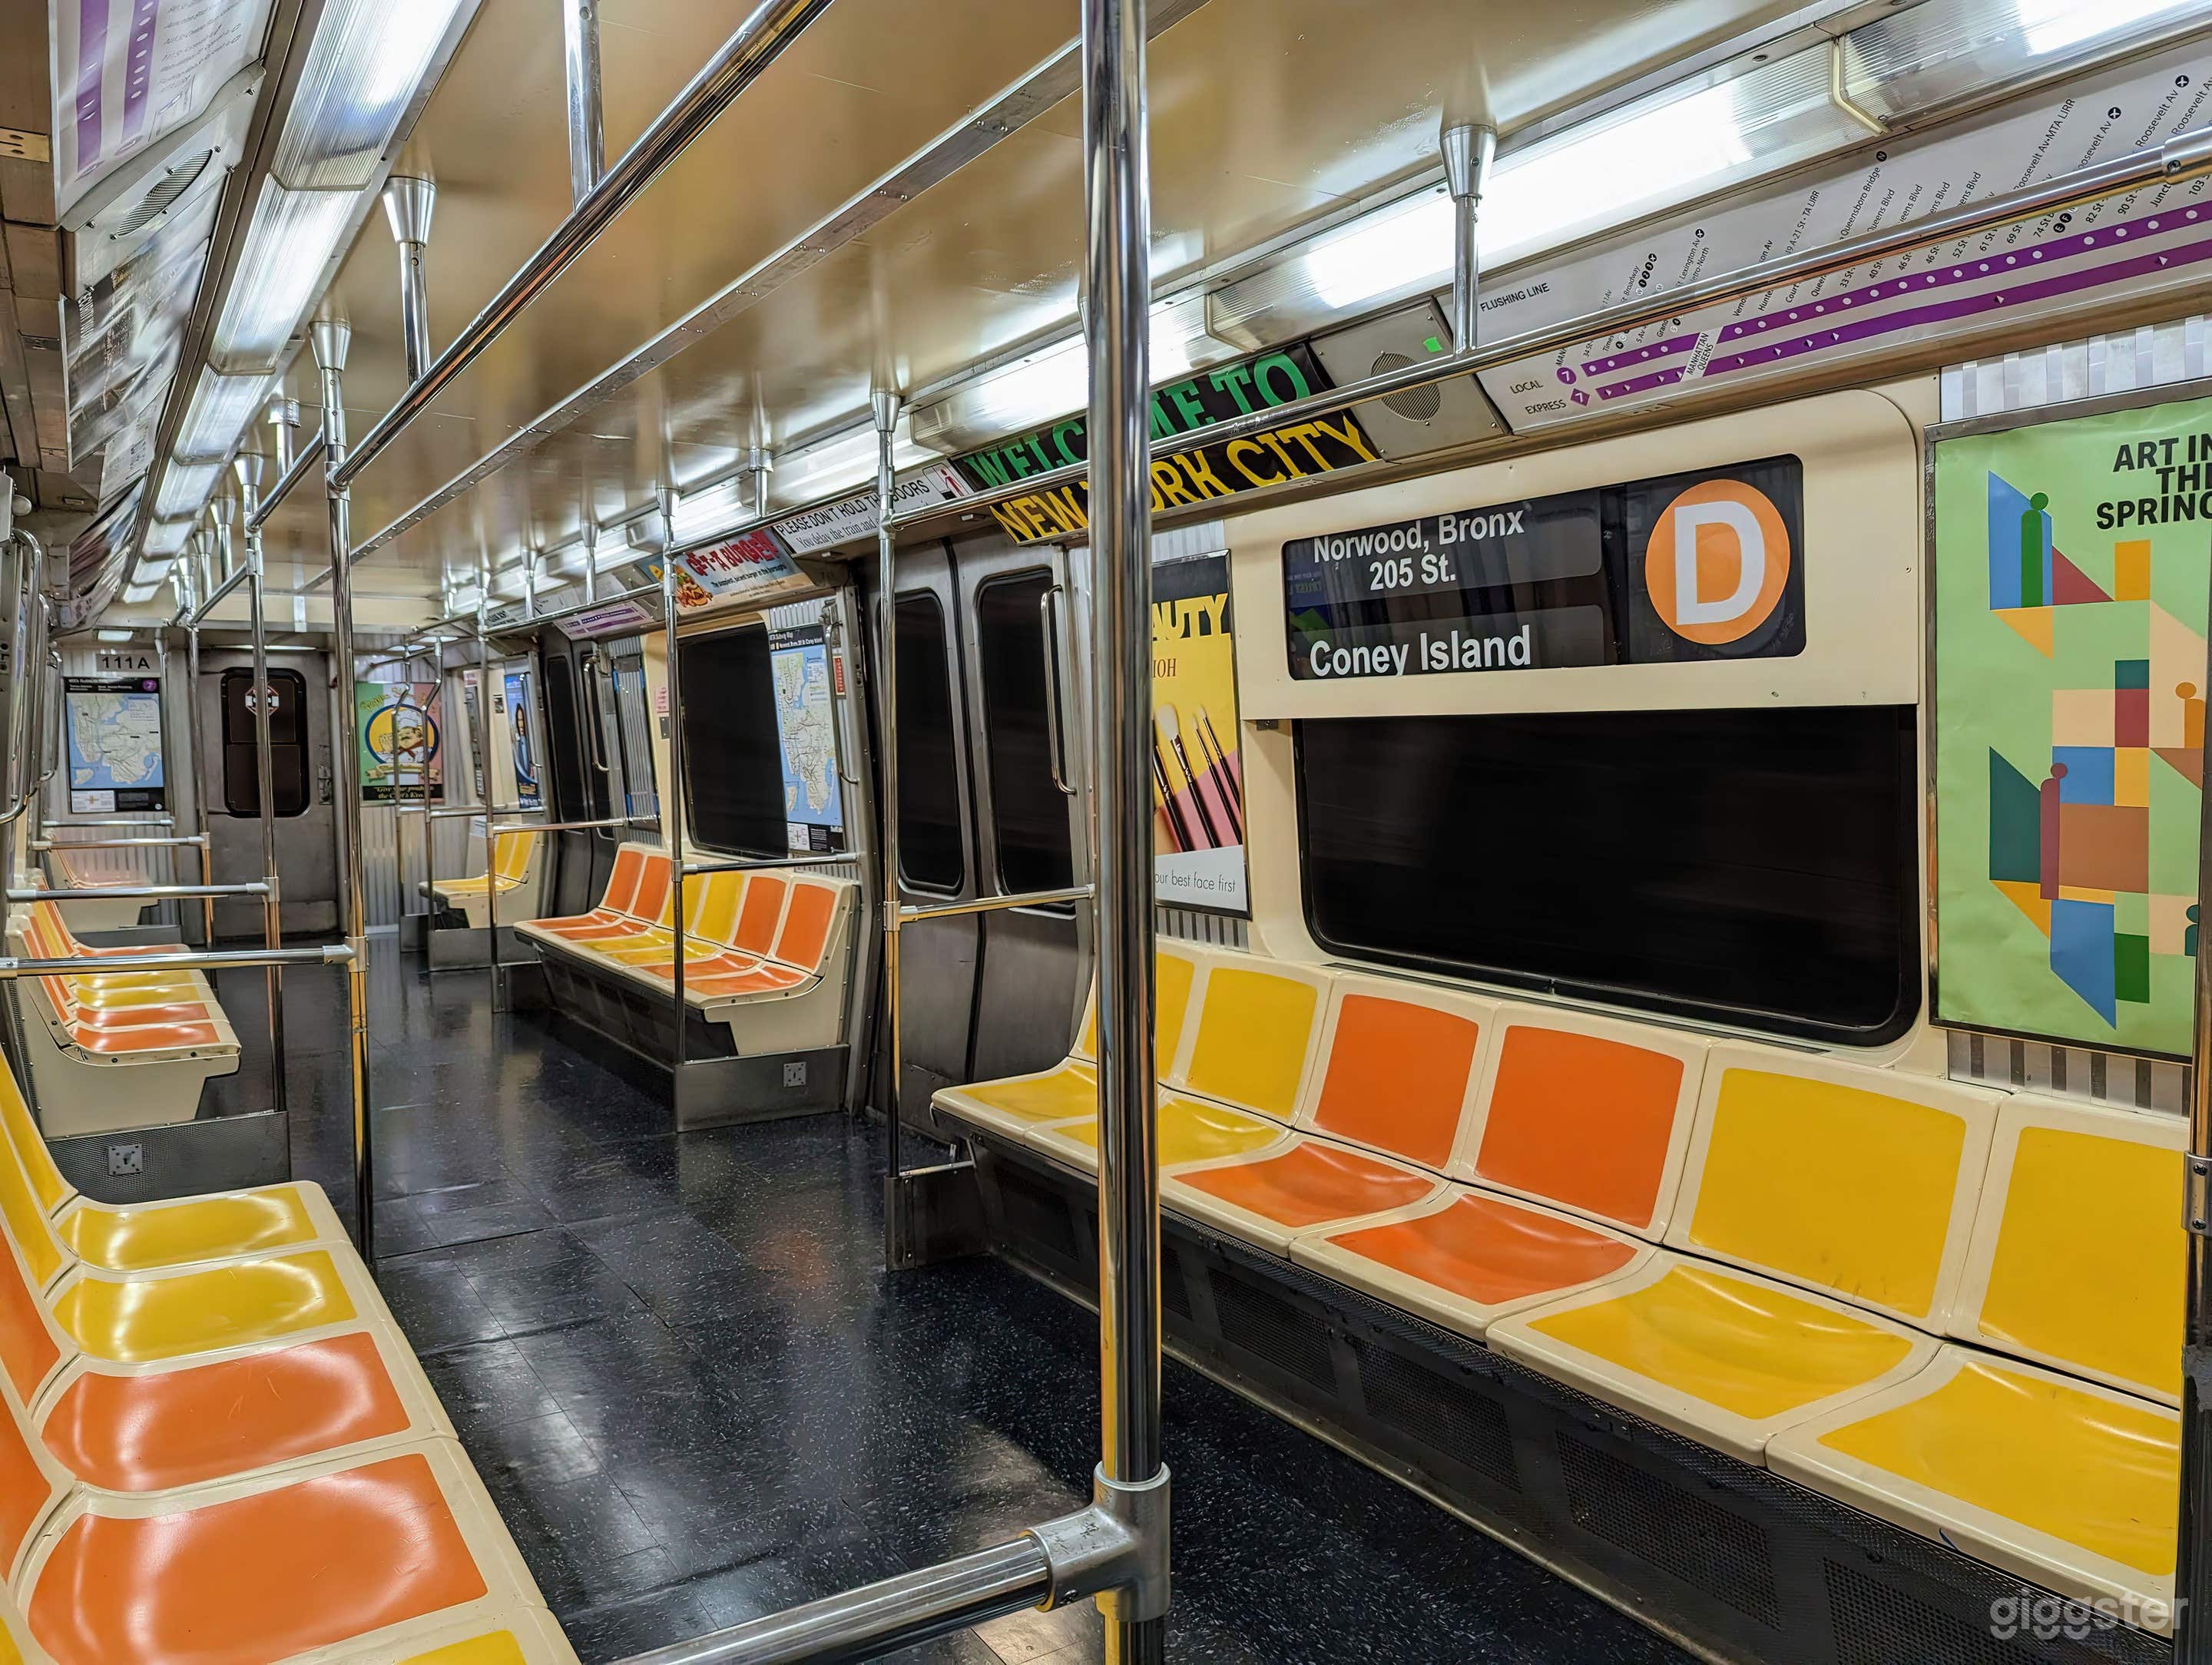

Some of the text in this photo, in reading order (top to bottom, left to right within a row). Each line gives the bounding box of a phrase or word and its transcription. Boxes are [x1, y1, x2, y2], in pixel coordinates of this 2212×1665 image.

[2058, 98, 2075, 121] LIRR
[2135, 89, 2178, 147] Roosevelt Av
[2171, 91, 2207, 135] Roosevelt
[2100, 121, 2111, 134] Av
[1966, 171, 1981, 190] Blvd
[2189, 180, 2205, 196] 103
[1807, 190, 1820, 207] LIRR
[1840, 167, 1881, 237] Queensboro Bridge
[1881, 188, 1895, 207] Blvd
[1909, 184, 1922, 203] Blvd
[1929, 181, 1950, 215] ens Blvd
[2085, 202, 2104, 223] 82 St
[2118, 202, 2131, 215] 90
[2007, 224, 2022, 244] 69 St
[2034, 218, 2051, 238] 74 St
[1763, 240, 1773, 250] Av
[1952, 239, 1968, 258] 52 St
[1980, 232, 1995, 252] 61 St
[1679, 247, 1696, 280] Lexington
[1692, 238, 1700, 248] Av
[1899, 261, 1906, 271] 46
[1926, 255, 1934, 264] 46
[1624, 265, 1641, 296] Broadway
[1839, 278, 1847, 288] 33
[1869, 269, 1878, 279] 40
[1480, 283, 1550, 312] FLUSHING LINE
[1733, 296, 1747, 317] Verno
[1758, 289, 1774, 312] Hunte
[1583, 349, 1590, 357] 34
[1603, 335, 1614, 352] Times
[1686, 333, 1709, 375] MANHATTAN
[1697, 343, 1714, 370] QUEENS
[1509, 379, 1544, 394] LOCAL
[1525, 399, 1567, 415] EXPRESS
[962, 353, 1311, 488] WELCE TO
[2113, 437, 2179, 472] ART
[989, 485, 1089, 544] NEW
[1227, 415, 1377, 488] CITY
[776, 516, 813, 536] PLEASE
[810, 508, 840, 527] DON'T
[836, 498, 868, 518] HOLD
[863, 492, 880, 508] TH
[796, 516, 877, 548] You delay the train and
[1314, 509, 1525, 563] Norwood, Bronx
[1369, 553, 1456, 591] 205 St.
[1674, 501, 1765, 626] D
[1310, 624, 1531, 677] Coney Island
[102, 656, 151, 670] 111A
[1171, 869, 1190, 888] best
[1194, 871, 1215, 890] face
[1218, 874, 1236, 892] first
